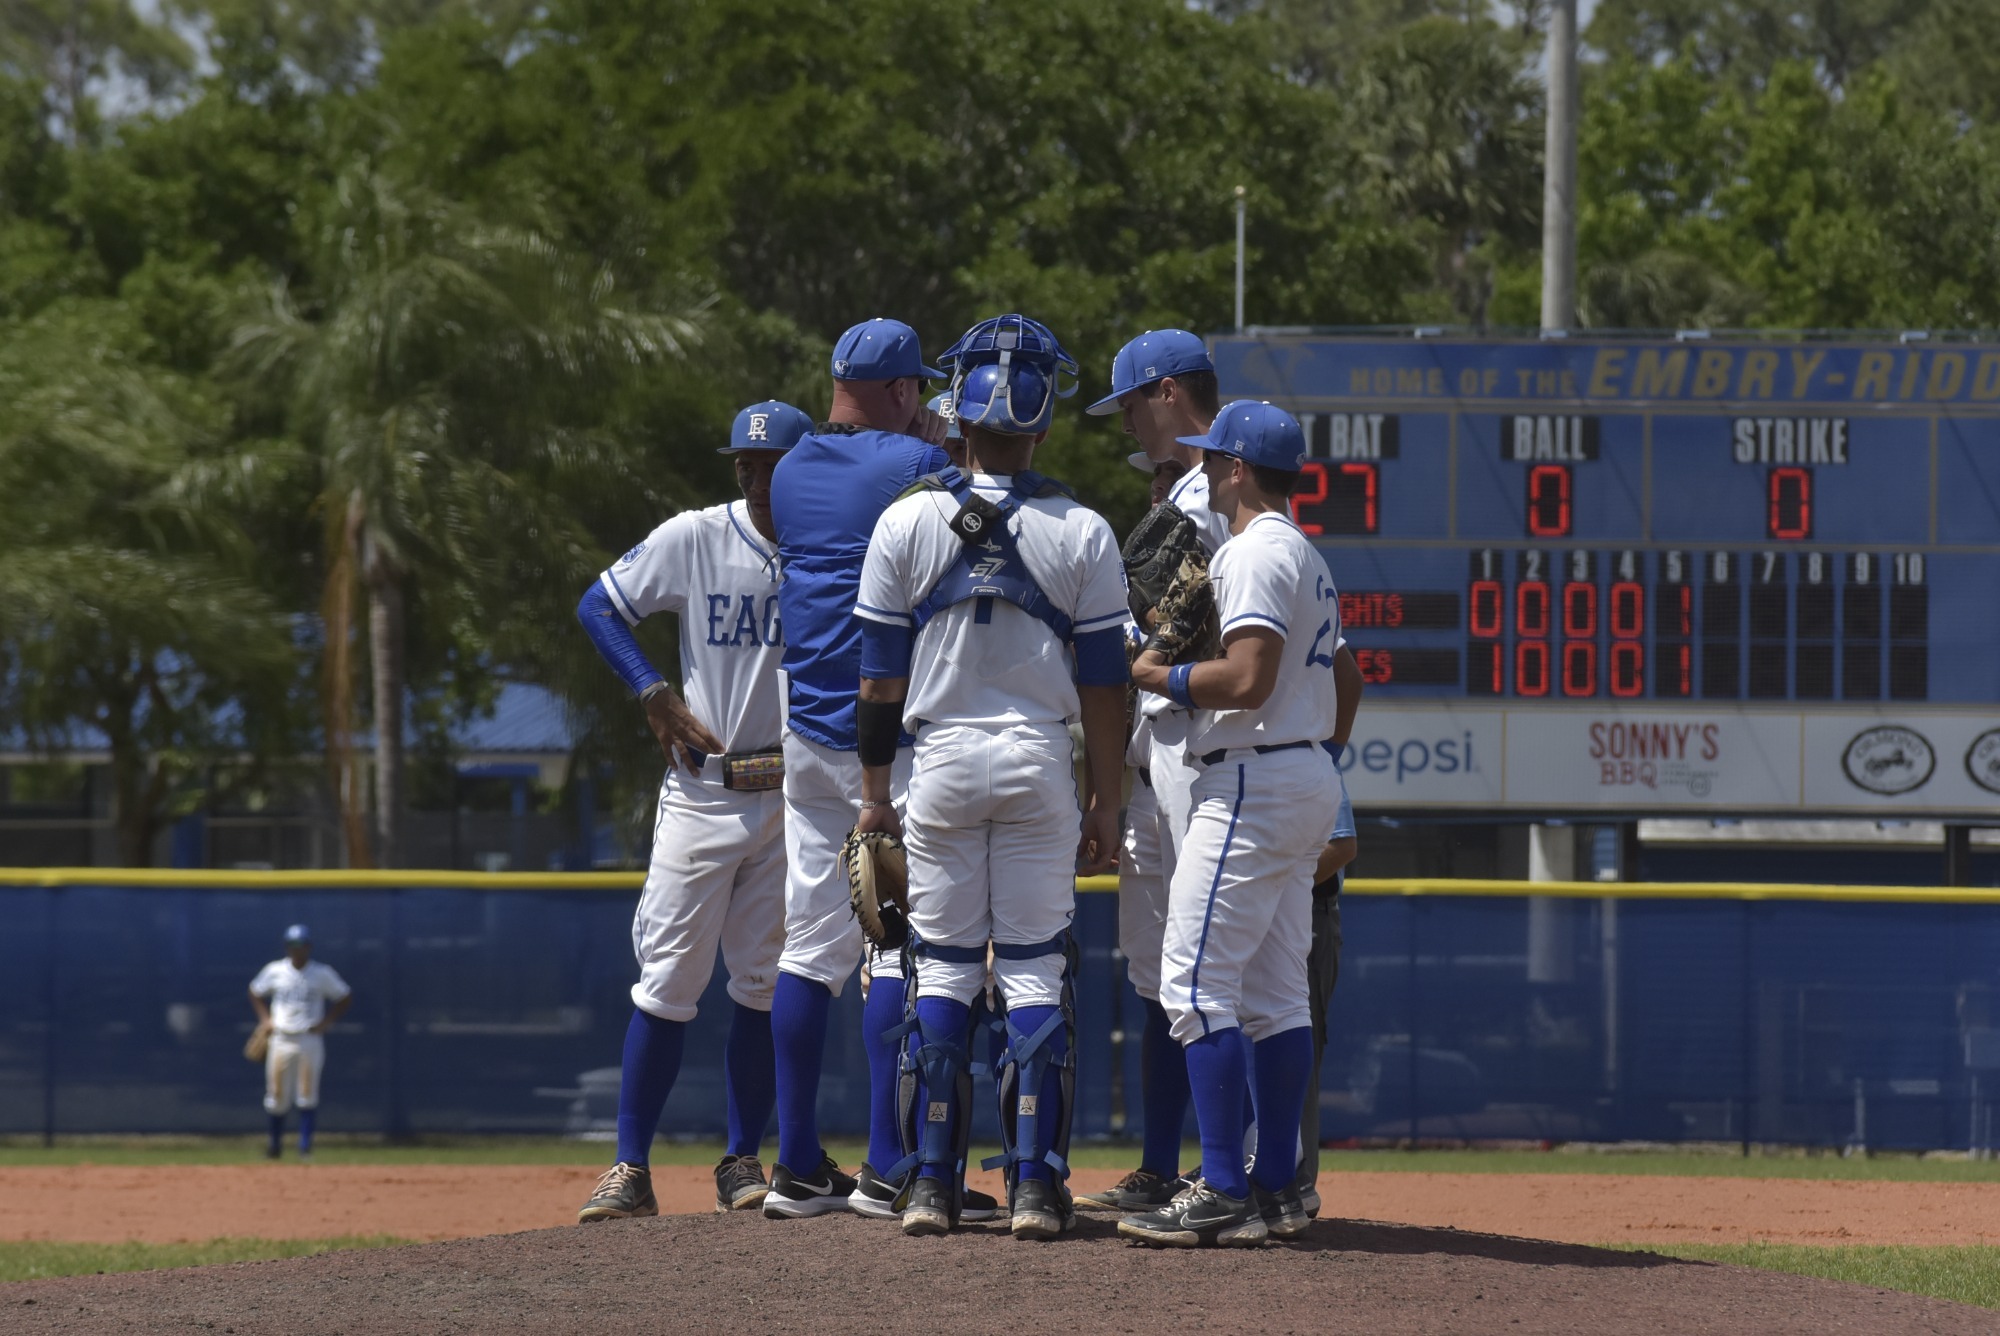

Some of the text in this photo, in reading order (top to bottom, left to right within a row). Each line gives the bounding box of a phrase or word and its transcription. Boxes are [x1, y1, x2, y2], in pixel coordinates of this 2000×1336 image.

[1350, 351, 2000, 399] HOME OF THE EMBRY-RIDD
[1330, 415, 1384, 459] BAT
[1513, 415, 1586, 461] BALL
[1734, 418, 1847, 464] STRIKE
[965, 514, 980, 530] GSC
[1289, 463, 1376, 536] 27
[1529, 465, 1570, 536] 0
[1769, 467, 1809, 539] 0
[1481, 549, 1923, 585] 1 2 3 4 5 6 7 8 9 10
[707, 593, 787, 648] EAG
[1338, 593, 1403, 628] GHTS
[1470, 580, 1501, 638] 0
[1516, 581, 1549, 638] 0
[1563, 582, 1597, 638] 0
[1610, 582, 1644, 639] 0
[1492, 642, 1502, 694] 1
[1516, 640, 1549, 697] 0
[1562, 640, 1596, 697] 0
[1680, 645, 1690, 695] 1
[1589, 722, 1720, 761] SONNY'S
[1600, 761, 1658, 789] BBQ
